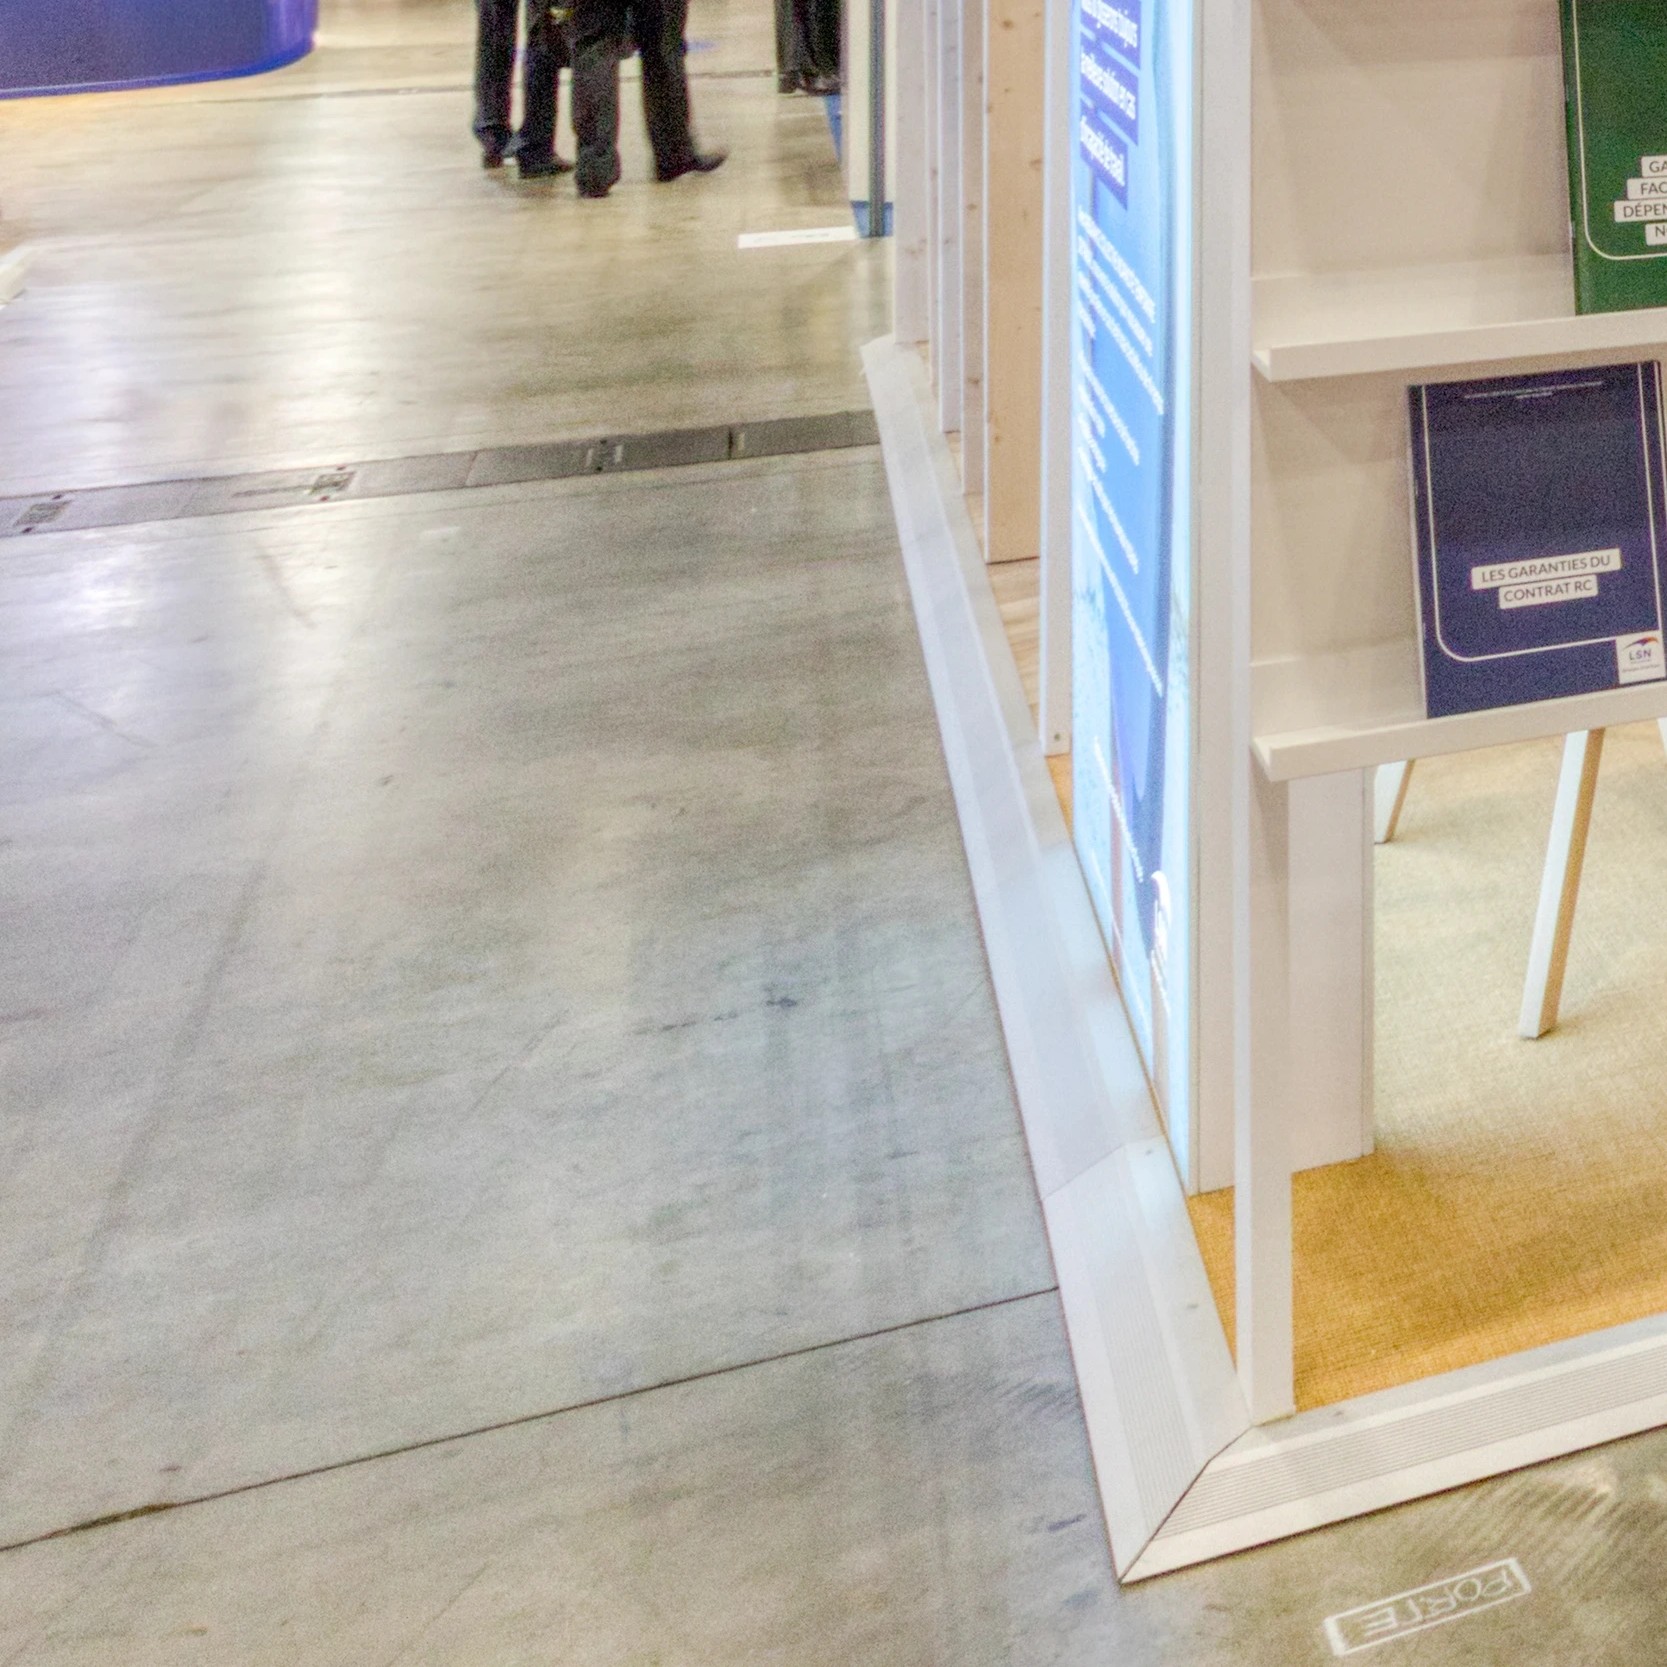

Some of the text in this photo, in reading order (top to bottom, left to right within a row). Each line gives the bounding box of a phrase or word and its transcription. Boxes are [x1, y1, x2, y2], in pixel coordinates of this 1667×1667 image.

[1482, 555, 1610, 583] LES GARANTIES DU
[1504, 579, 1592, 602] CONTRAT RC
[1629, 649, 1651, 660] LSN
[1361, 1569, 1513, 1635] PORTE
